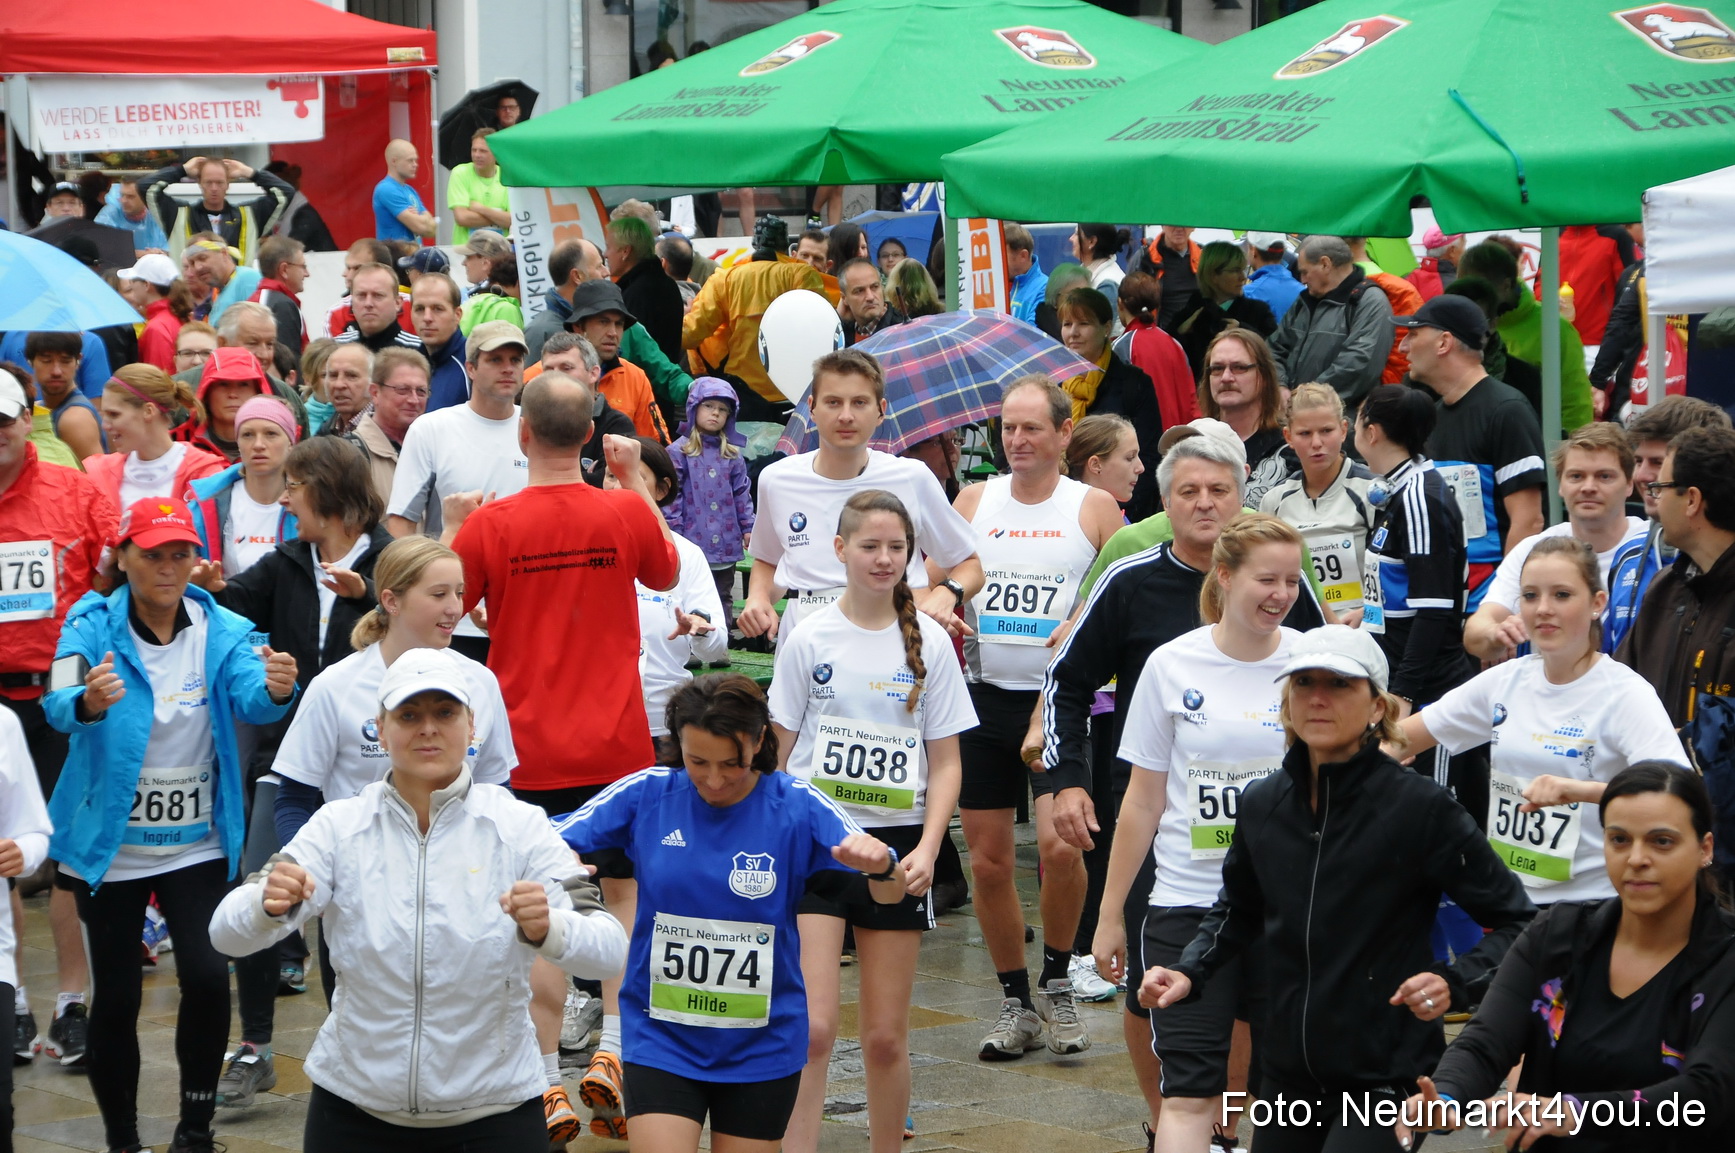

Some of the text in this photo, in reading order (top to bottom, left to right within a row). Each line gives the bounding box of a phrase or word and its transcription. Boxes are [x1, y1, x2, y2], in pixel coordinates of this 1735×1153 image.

[668, 82, 782, 100] Neumarkter
[981, 94, 1090, 113] Lam
[1178, 90, 1336, 112] Neumarkter
[40, 100, 262, 127] WERDE LEBENSRETTER!
[1606, 105, 1735, 131] Lam
[63, 129, 101, 141] LASS
[1104, 113, 1320, 143] Lammsbräu
[249, 535, 277, 544] KLE
[788, 533, 810, 543] PARTL
[1009, 530, 1067, 538] KLEBL
[0, 549, 36, 559] eumarkt
[1309, 542, 1339, 553] eumarkt
[1011, 572, 1052, 582] Neumarkt
[800, 596, 829, 605] PARTL
[985, 583, 1059, 615] 2697
[1325, 588, 1342, 600] dia
[0, 598, 32, 611] chael
[998, 619, 1038, 634] Roland
[820, 724, 902, 746] PARTL Neumarkt
[360, 744, 380, 753] PAR
[823, 740, 908, 784] 5038
[152, 775, 197, 787] Neumarkt
[1188, 768, 1225, 781] PARTL
[835, 784, 888, 804] Barbara
[1492, 779, 1517, 796] PARTL
[129, 786, 199, 823] 2681
[1199, 783, 1242, 820] 50
[1496, 796, 1571, 850] 5037
[143, 830, 182, 846] Ingrid
[661, 839, 687, 848] adidas
[745, 857, 761, 871] SV
[1510, 850, 1537, 872] Lena
[735, 871, 770, 885] STAUF
[743, 884, 762, 893] 1980
[655, 923, 752, 943] PARTL Neumarkt
[662, 941, 761, 989] 5074
[687, 993, 728, 1013] Hilde
